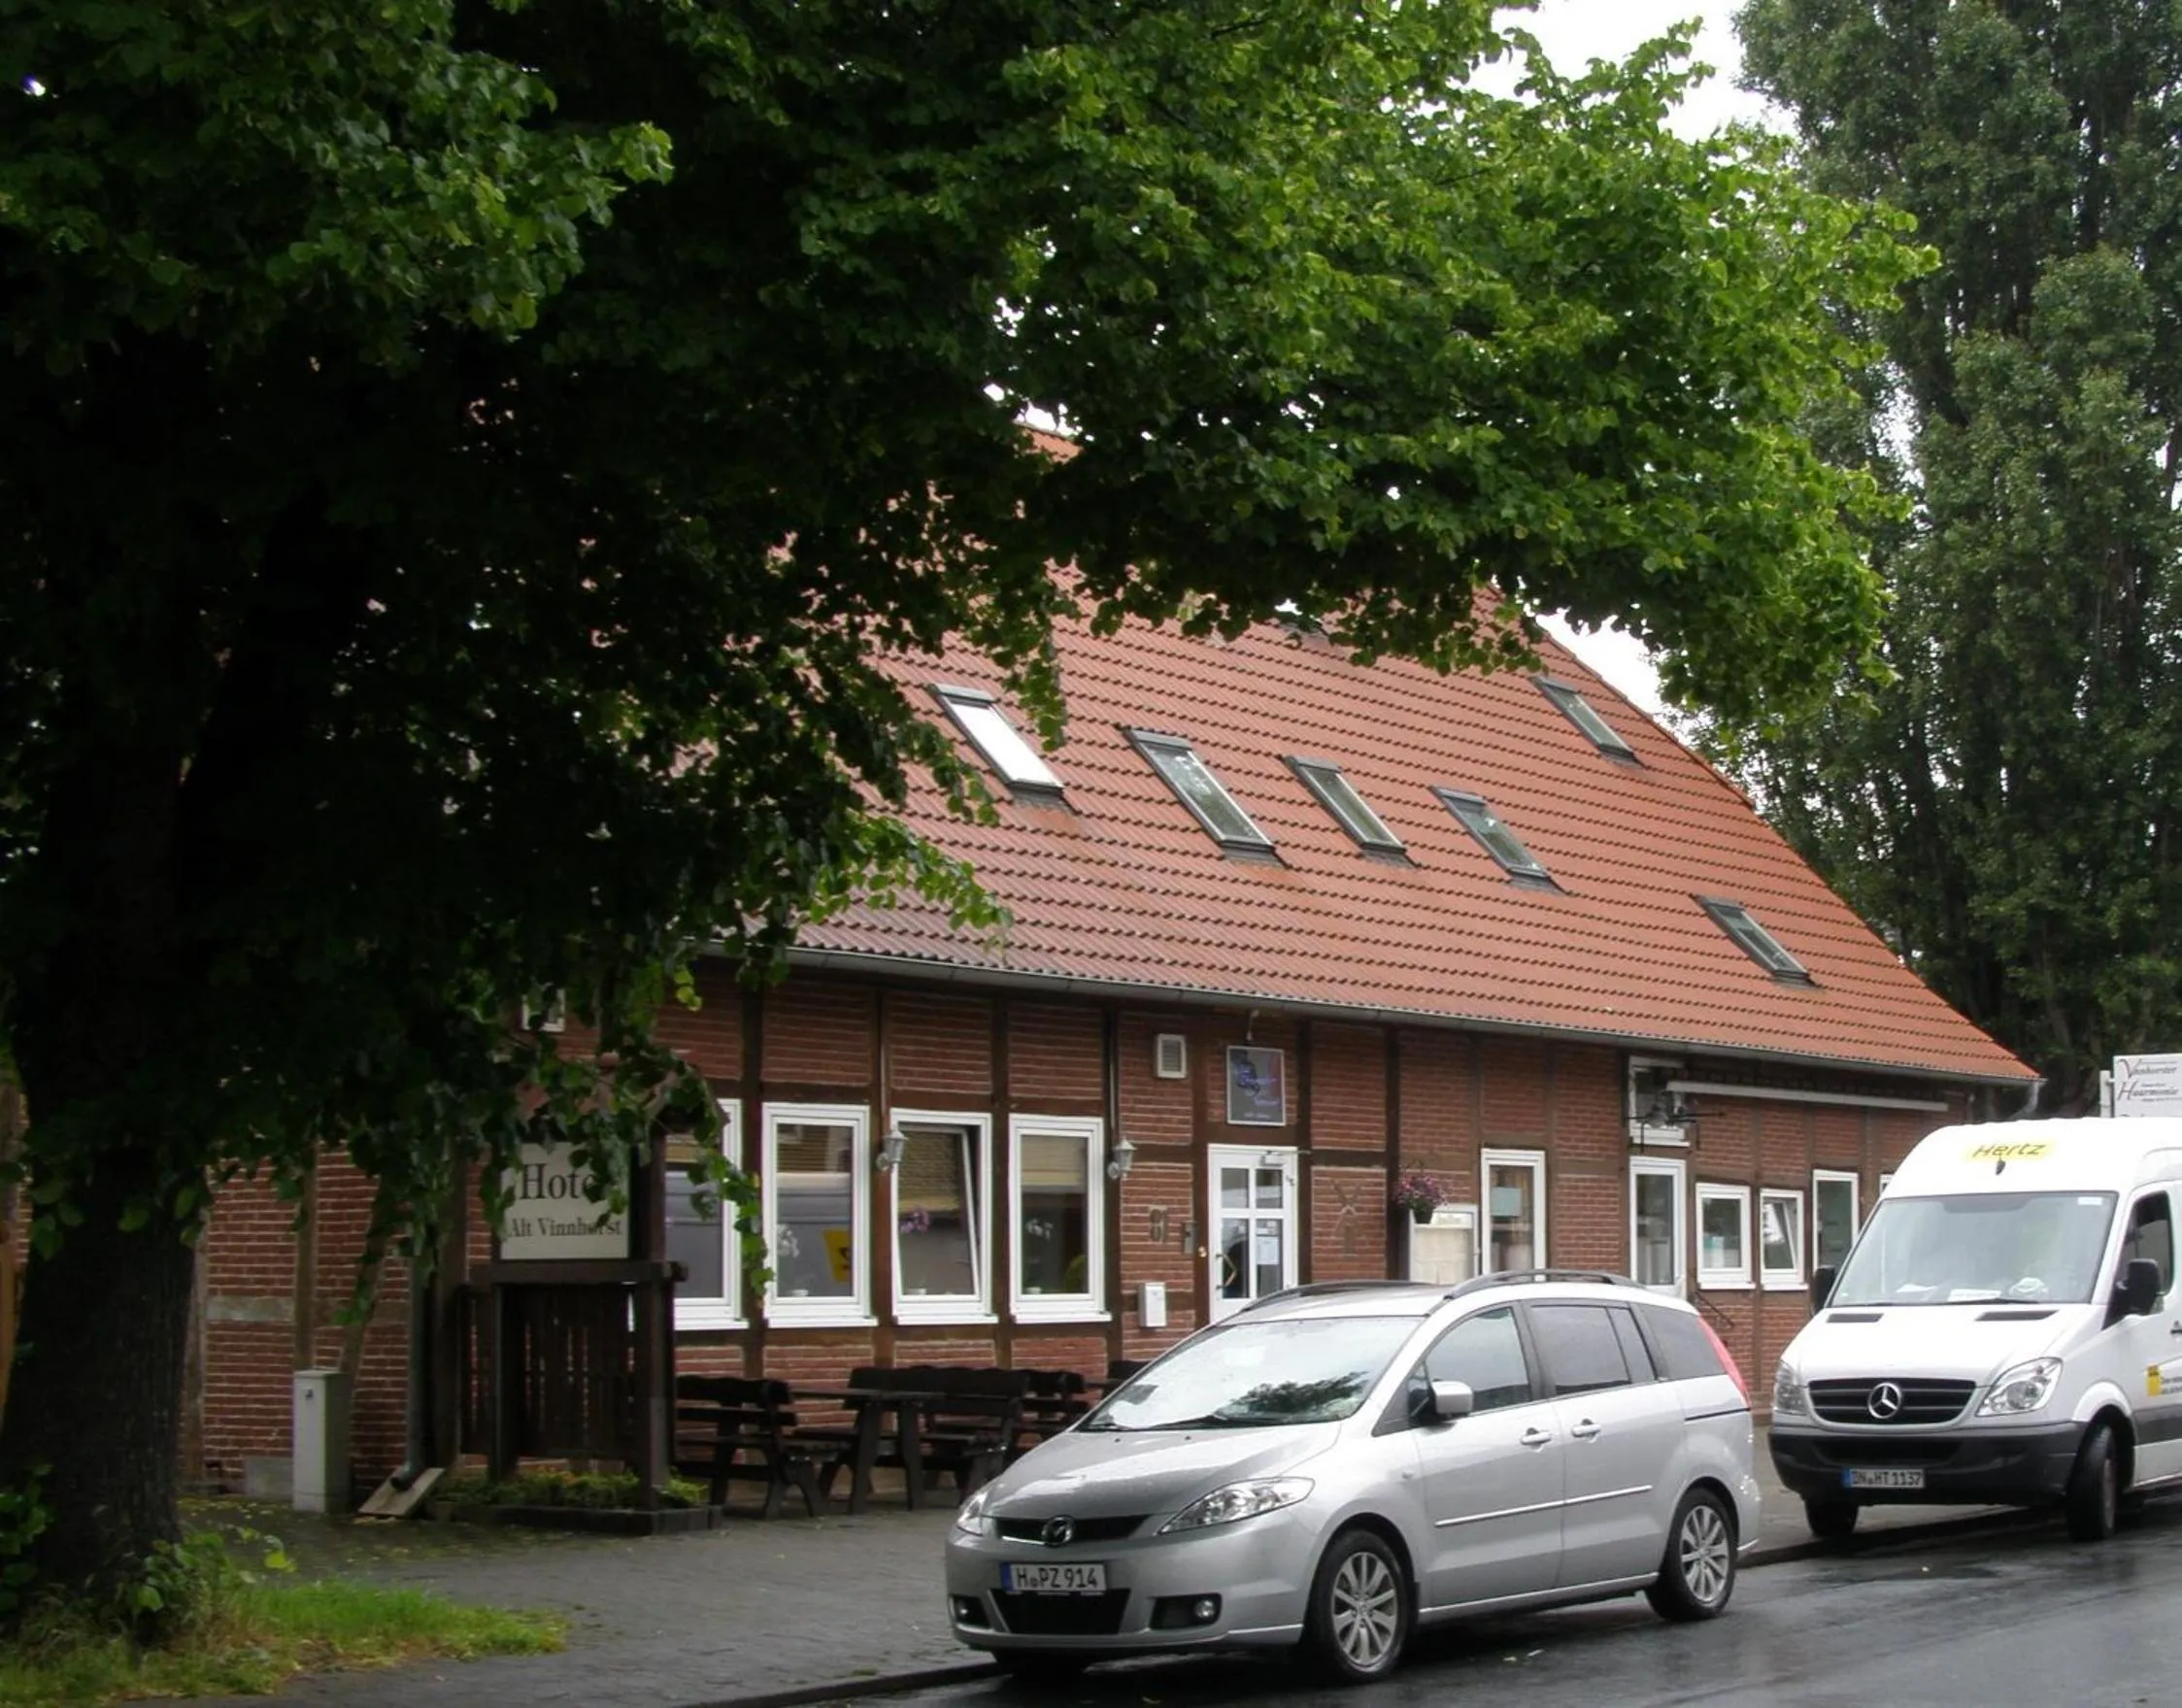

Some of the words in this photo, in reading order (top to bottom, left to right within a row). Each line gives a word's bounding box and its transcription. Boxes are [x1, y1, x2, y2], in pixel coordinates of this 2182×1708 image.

[1972, 1143, 2047, 1157] Hertz
[520, 1163, 602, 1200] Hote
[511, 1218, 532, 1237] Alt
[1064, 1567, 1097, 1588] 914
